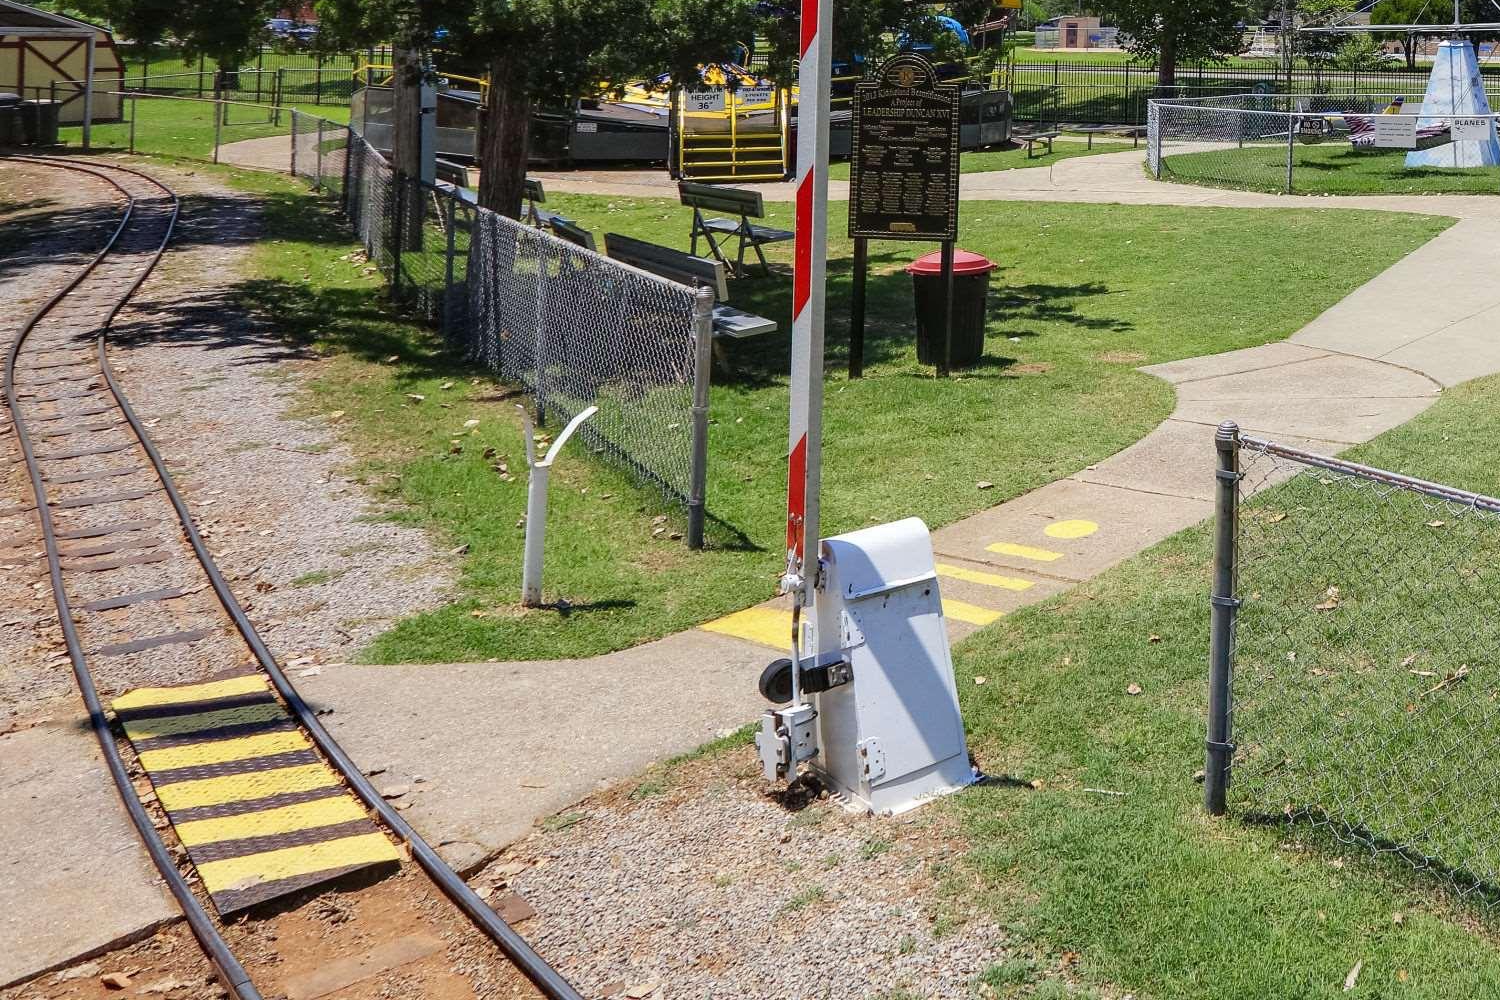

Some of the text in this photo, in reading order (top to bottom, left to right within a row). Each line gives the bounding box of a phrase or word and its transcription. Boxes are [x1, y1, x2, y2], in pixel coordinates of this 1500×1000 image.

[896, 97, 915, 108] Project
[863, 107, 905, 117] LEADERSHIP
[906, 108, 936, 118] DUNCAN
